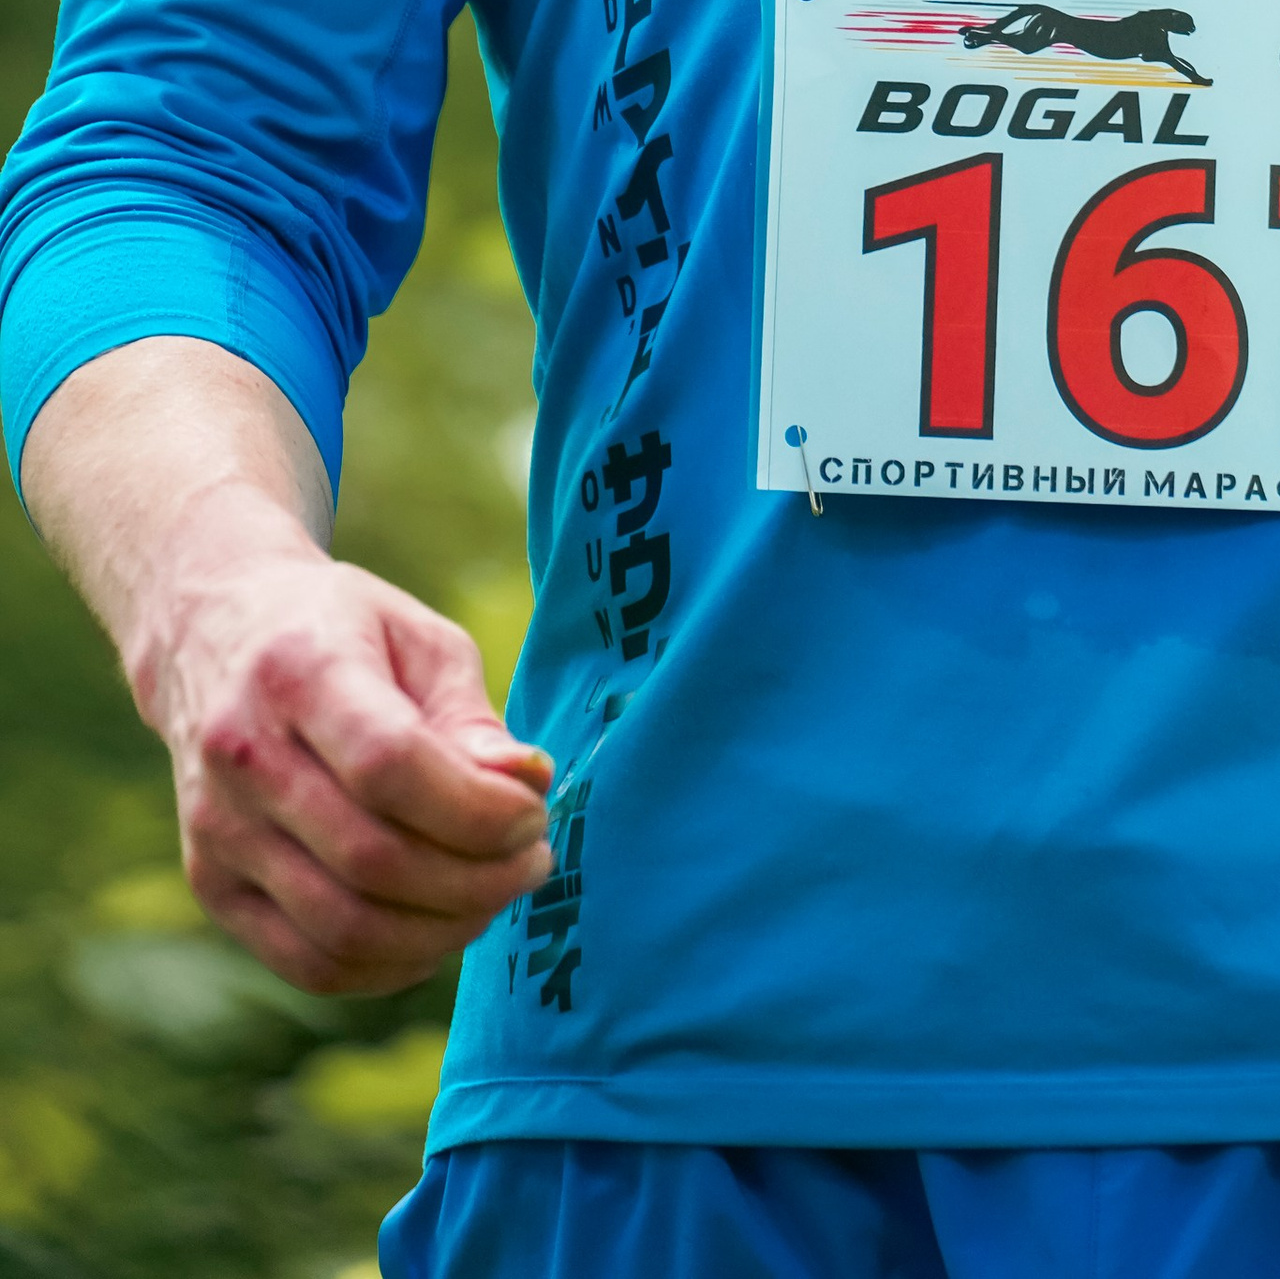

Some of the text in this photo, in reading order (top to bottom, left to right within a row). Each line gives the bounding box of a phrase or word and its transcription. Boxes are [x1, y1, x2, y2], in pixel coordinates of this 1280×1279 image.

[856, 80, 1210, 146] BOGAL
[593, 81, 636, 335] MND,
[819, 457, 1126, 496] СПОРТИВНЫЙ
